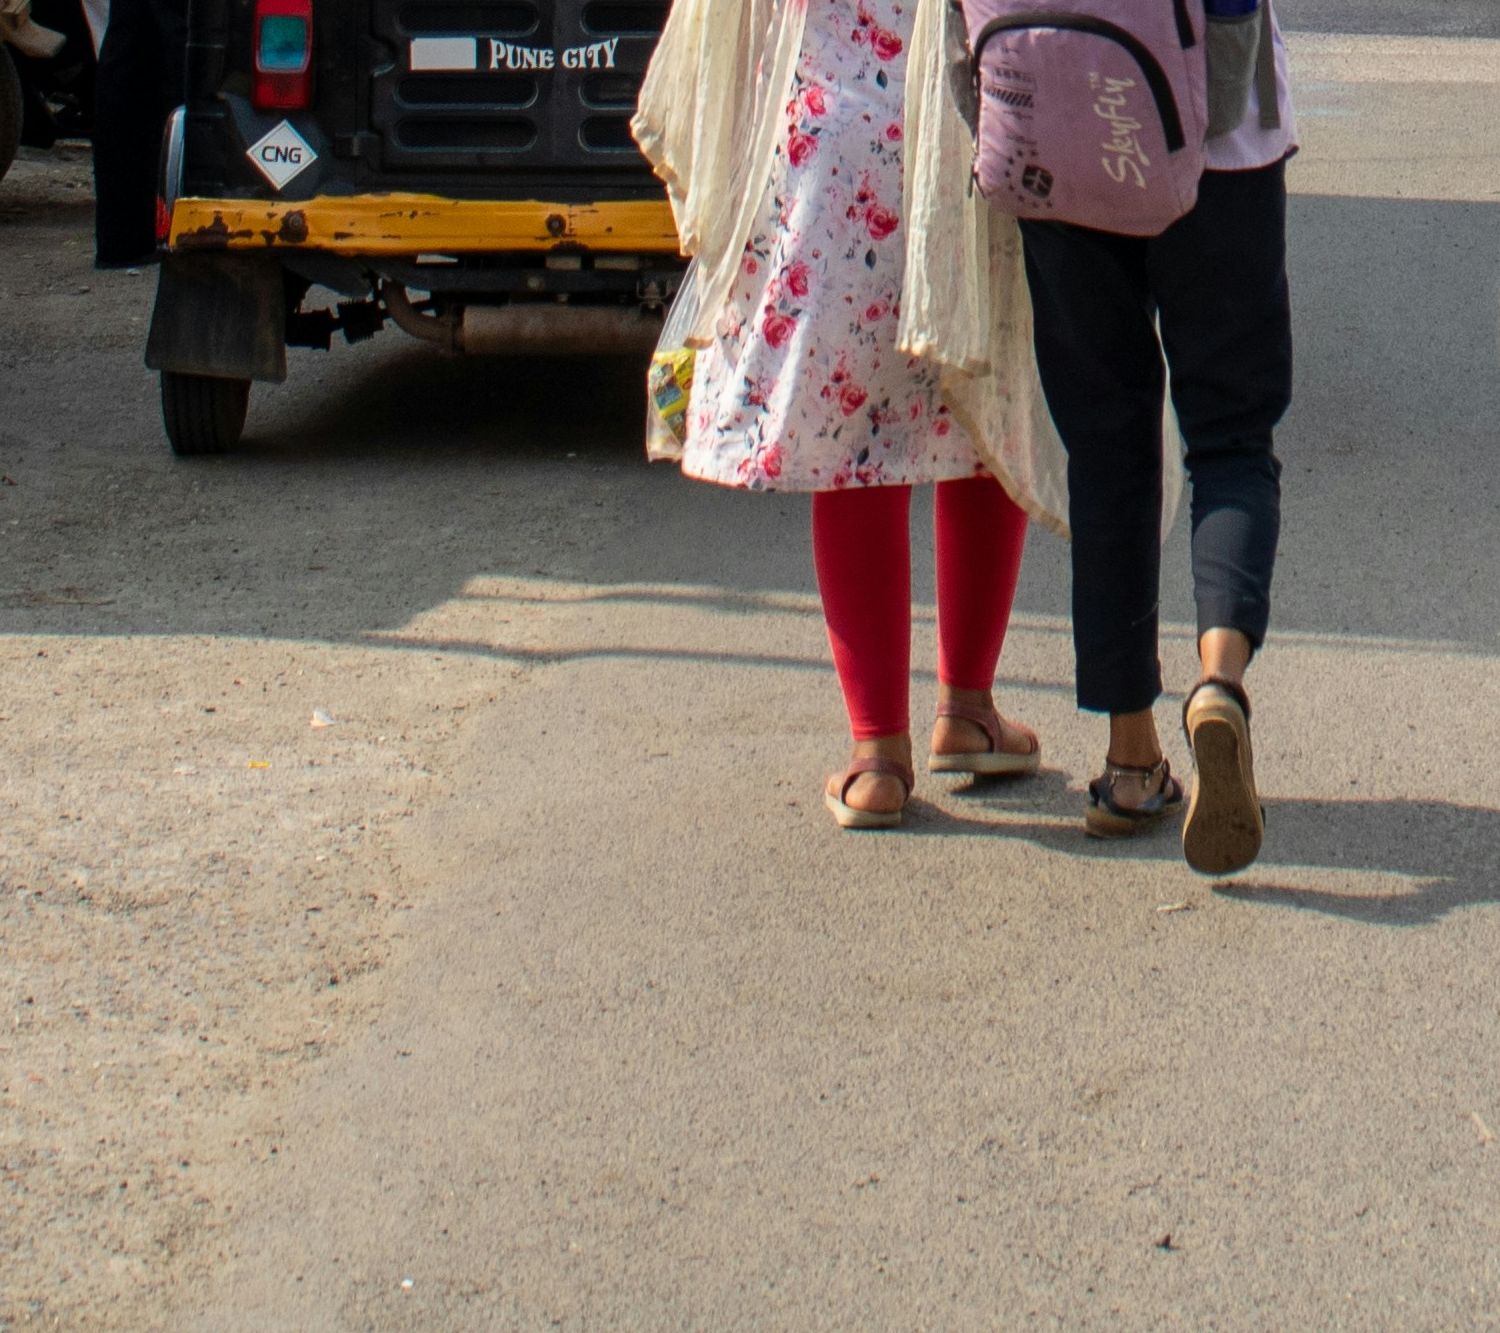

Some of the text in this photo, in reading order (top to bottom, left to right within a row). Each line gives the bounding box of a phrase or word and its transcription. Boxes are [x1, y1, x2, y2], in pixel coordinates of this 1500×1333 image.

[489, 37, 619, 69] PUNE CITY
[261, 145, 302, 164] CNG
